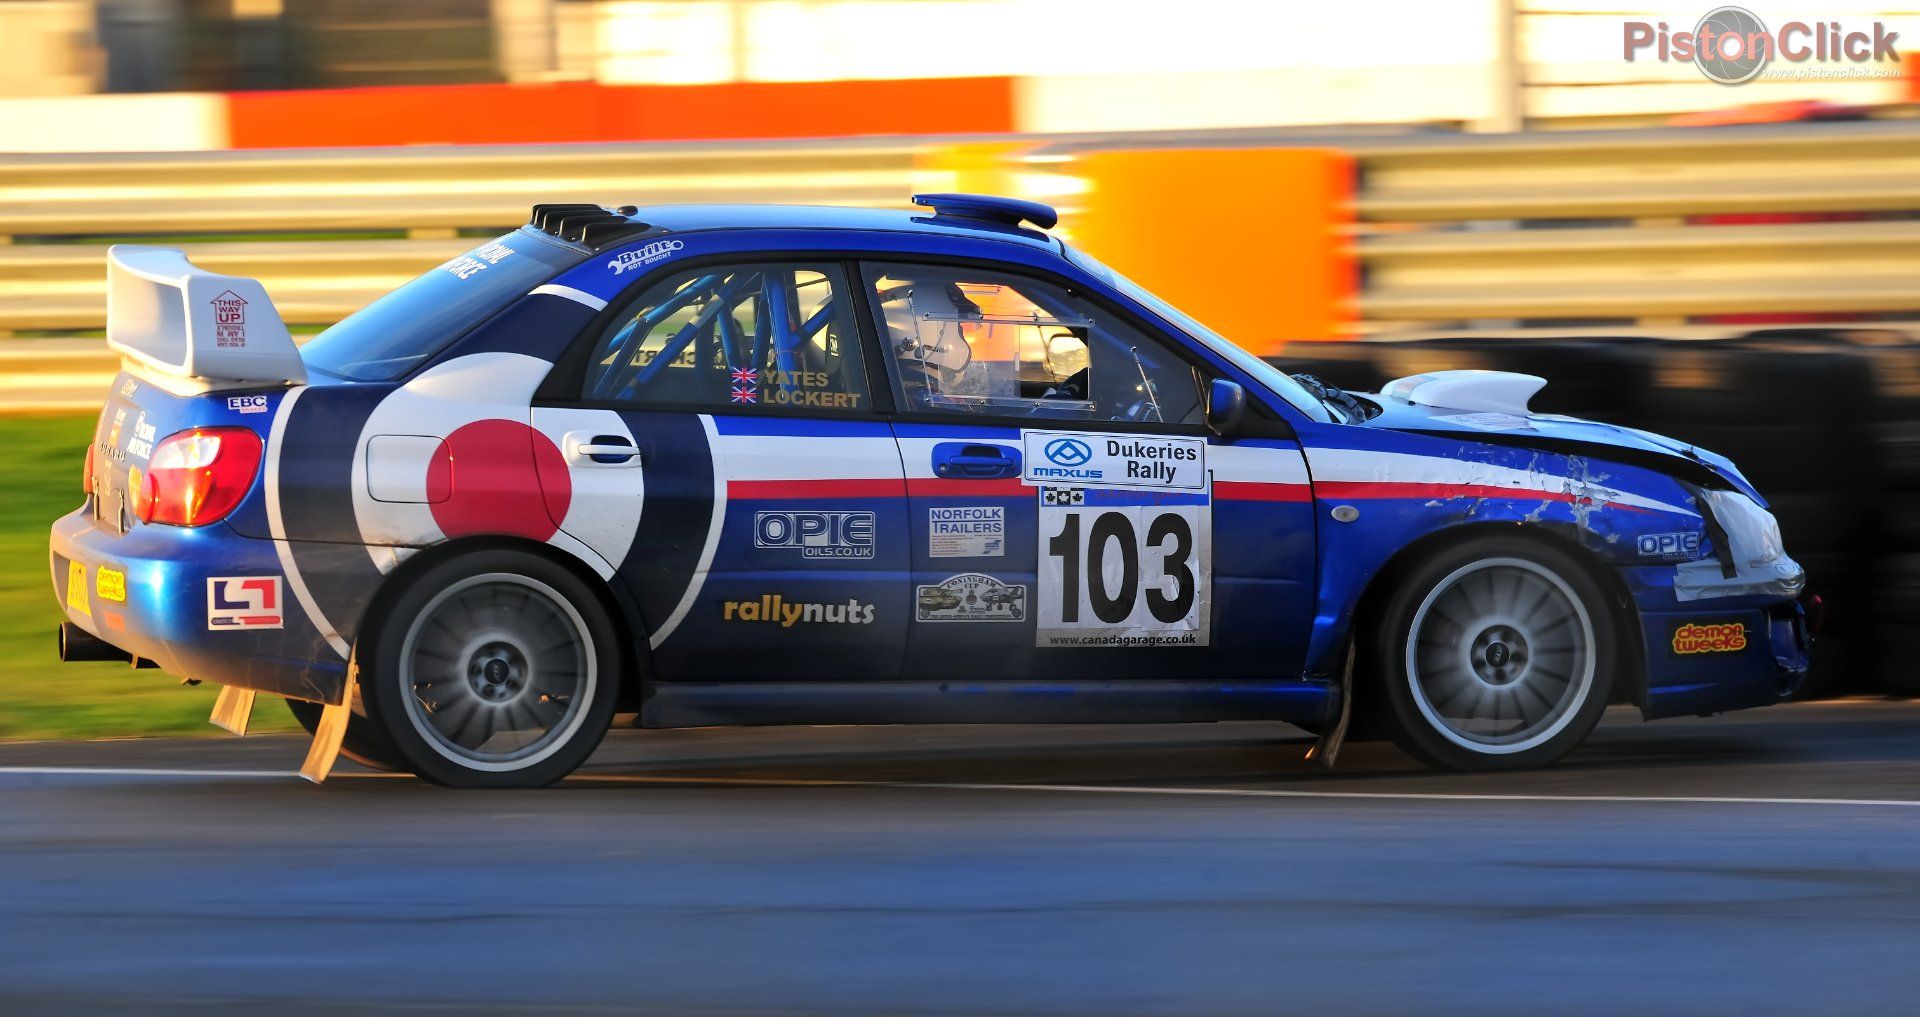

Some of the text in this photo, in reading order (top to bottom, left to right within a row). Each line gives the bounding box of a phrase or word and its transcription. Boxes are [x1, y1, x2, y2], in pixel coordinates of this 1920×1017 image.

[627, 251, 672, 271] NOT BOUGHT
[219, 313, 241, 322] UP
[763, 369, 829, 388] YATES
[230, 397, 266, 408] EBC
[763, 388, 862, 408] LOCKERT
[1106, 440, 1197, 461] Dukeries
[1033, 467, 1103, 479] MAXUS
[1127, 460, 1177, 484] Rally
[931, 508, 1002, 519] NORFOLK
[757, 513, 873, 547] OPIE
[932, 521, 1002, 534] TRAILERS
[1640, 533, 1699, 553] OPIE
[805, 547, 871, 557] OILS.CO.UK
[1050, 511, 1195, 624] 103
[946, 576, 997, 589] CONINGHAM
[723, 594, 875, 628] rallynuts
[1050, 634, 1196, 647] www.canadagarage.co.uk
[1677, 624, 1744, 641] demon
[1674, 637, 1746, 653] tweeks
